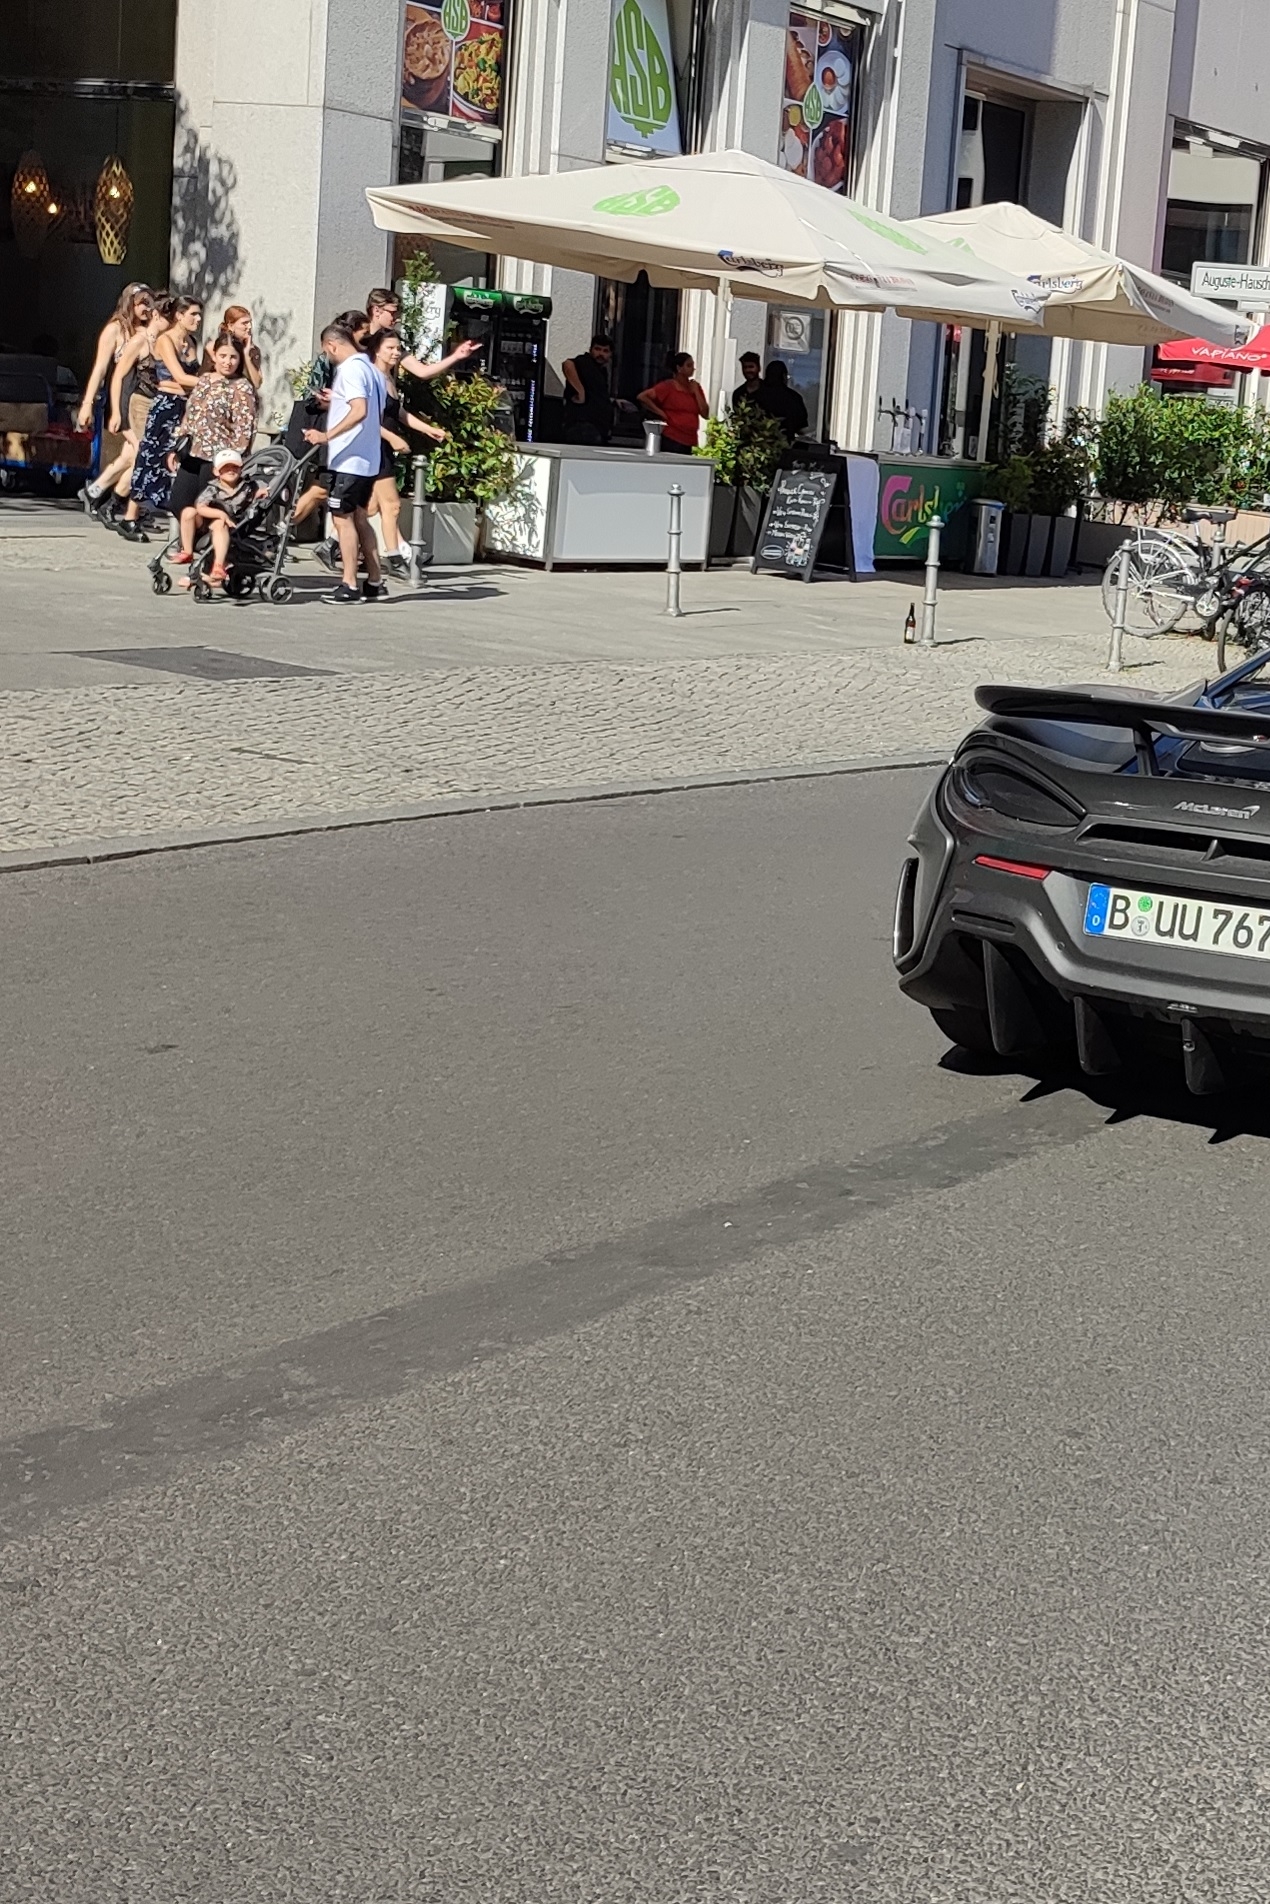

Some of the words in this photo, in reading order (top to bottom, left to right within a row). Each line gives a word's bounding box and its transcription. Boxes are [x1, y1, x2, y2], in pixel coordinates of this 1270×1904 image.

[1174, 801, 1250, 820] McLaren
[1109, 894, 1131, 930] B
[1155, 900, 1203, 942] UU
